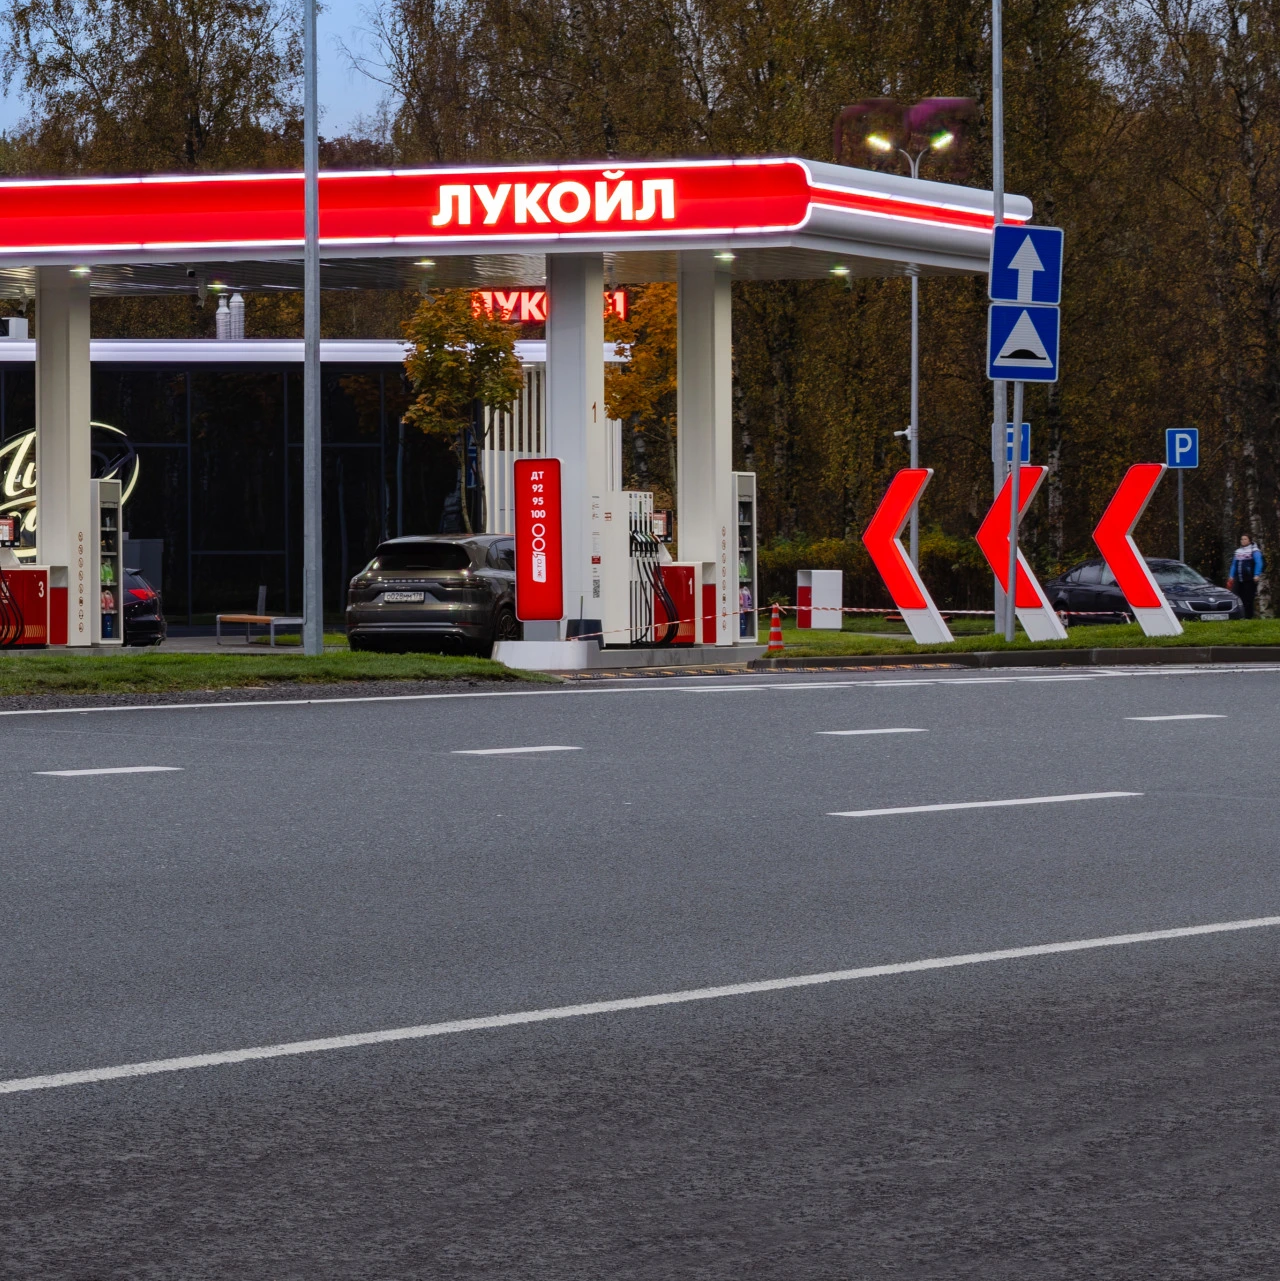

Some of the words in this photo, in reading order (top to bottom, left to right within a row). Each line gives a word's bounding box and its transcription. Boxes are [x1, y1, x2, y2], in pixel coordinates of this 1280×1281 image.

[432, 170, 675, 226] ЛУКОЙЛ
[1175, 433, 1192, 463] P
[530, 471, 544, 481] ДТ
[532, 484, 544, 493] 92
[532, 497, 544, 505] 95
[530, 510, 546, 518] 100
[38, 581, 45, 598] 3
[688, 577, 693, 595] 1
